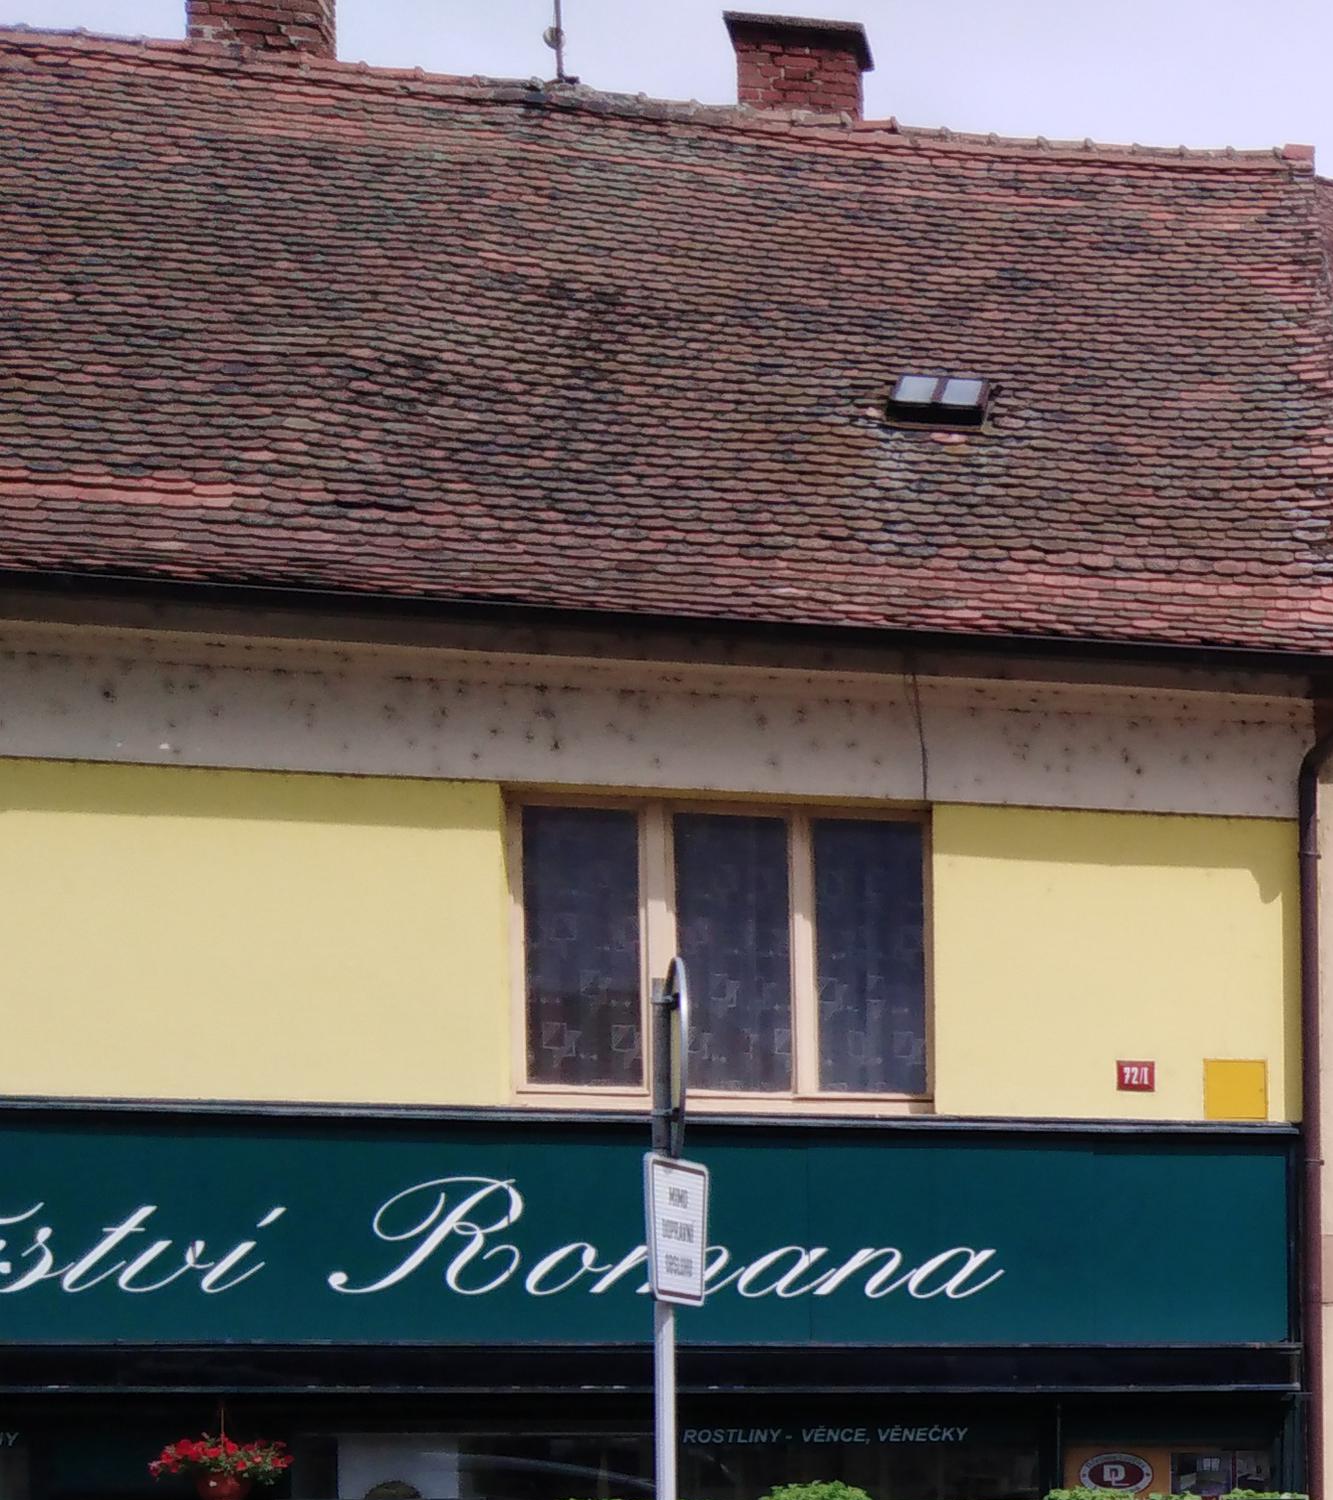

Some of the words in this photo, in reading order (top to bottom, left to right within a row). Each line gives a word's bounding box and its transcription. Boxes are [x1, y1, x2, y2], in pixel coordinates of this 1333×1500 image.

[683, 1428, 781, 1444] ROSTLINY
[801, 1425, 871, 1445] VĚNCE,
[877, 1424, 968, 1443] VĚNEČKY
